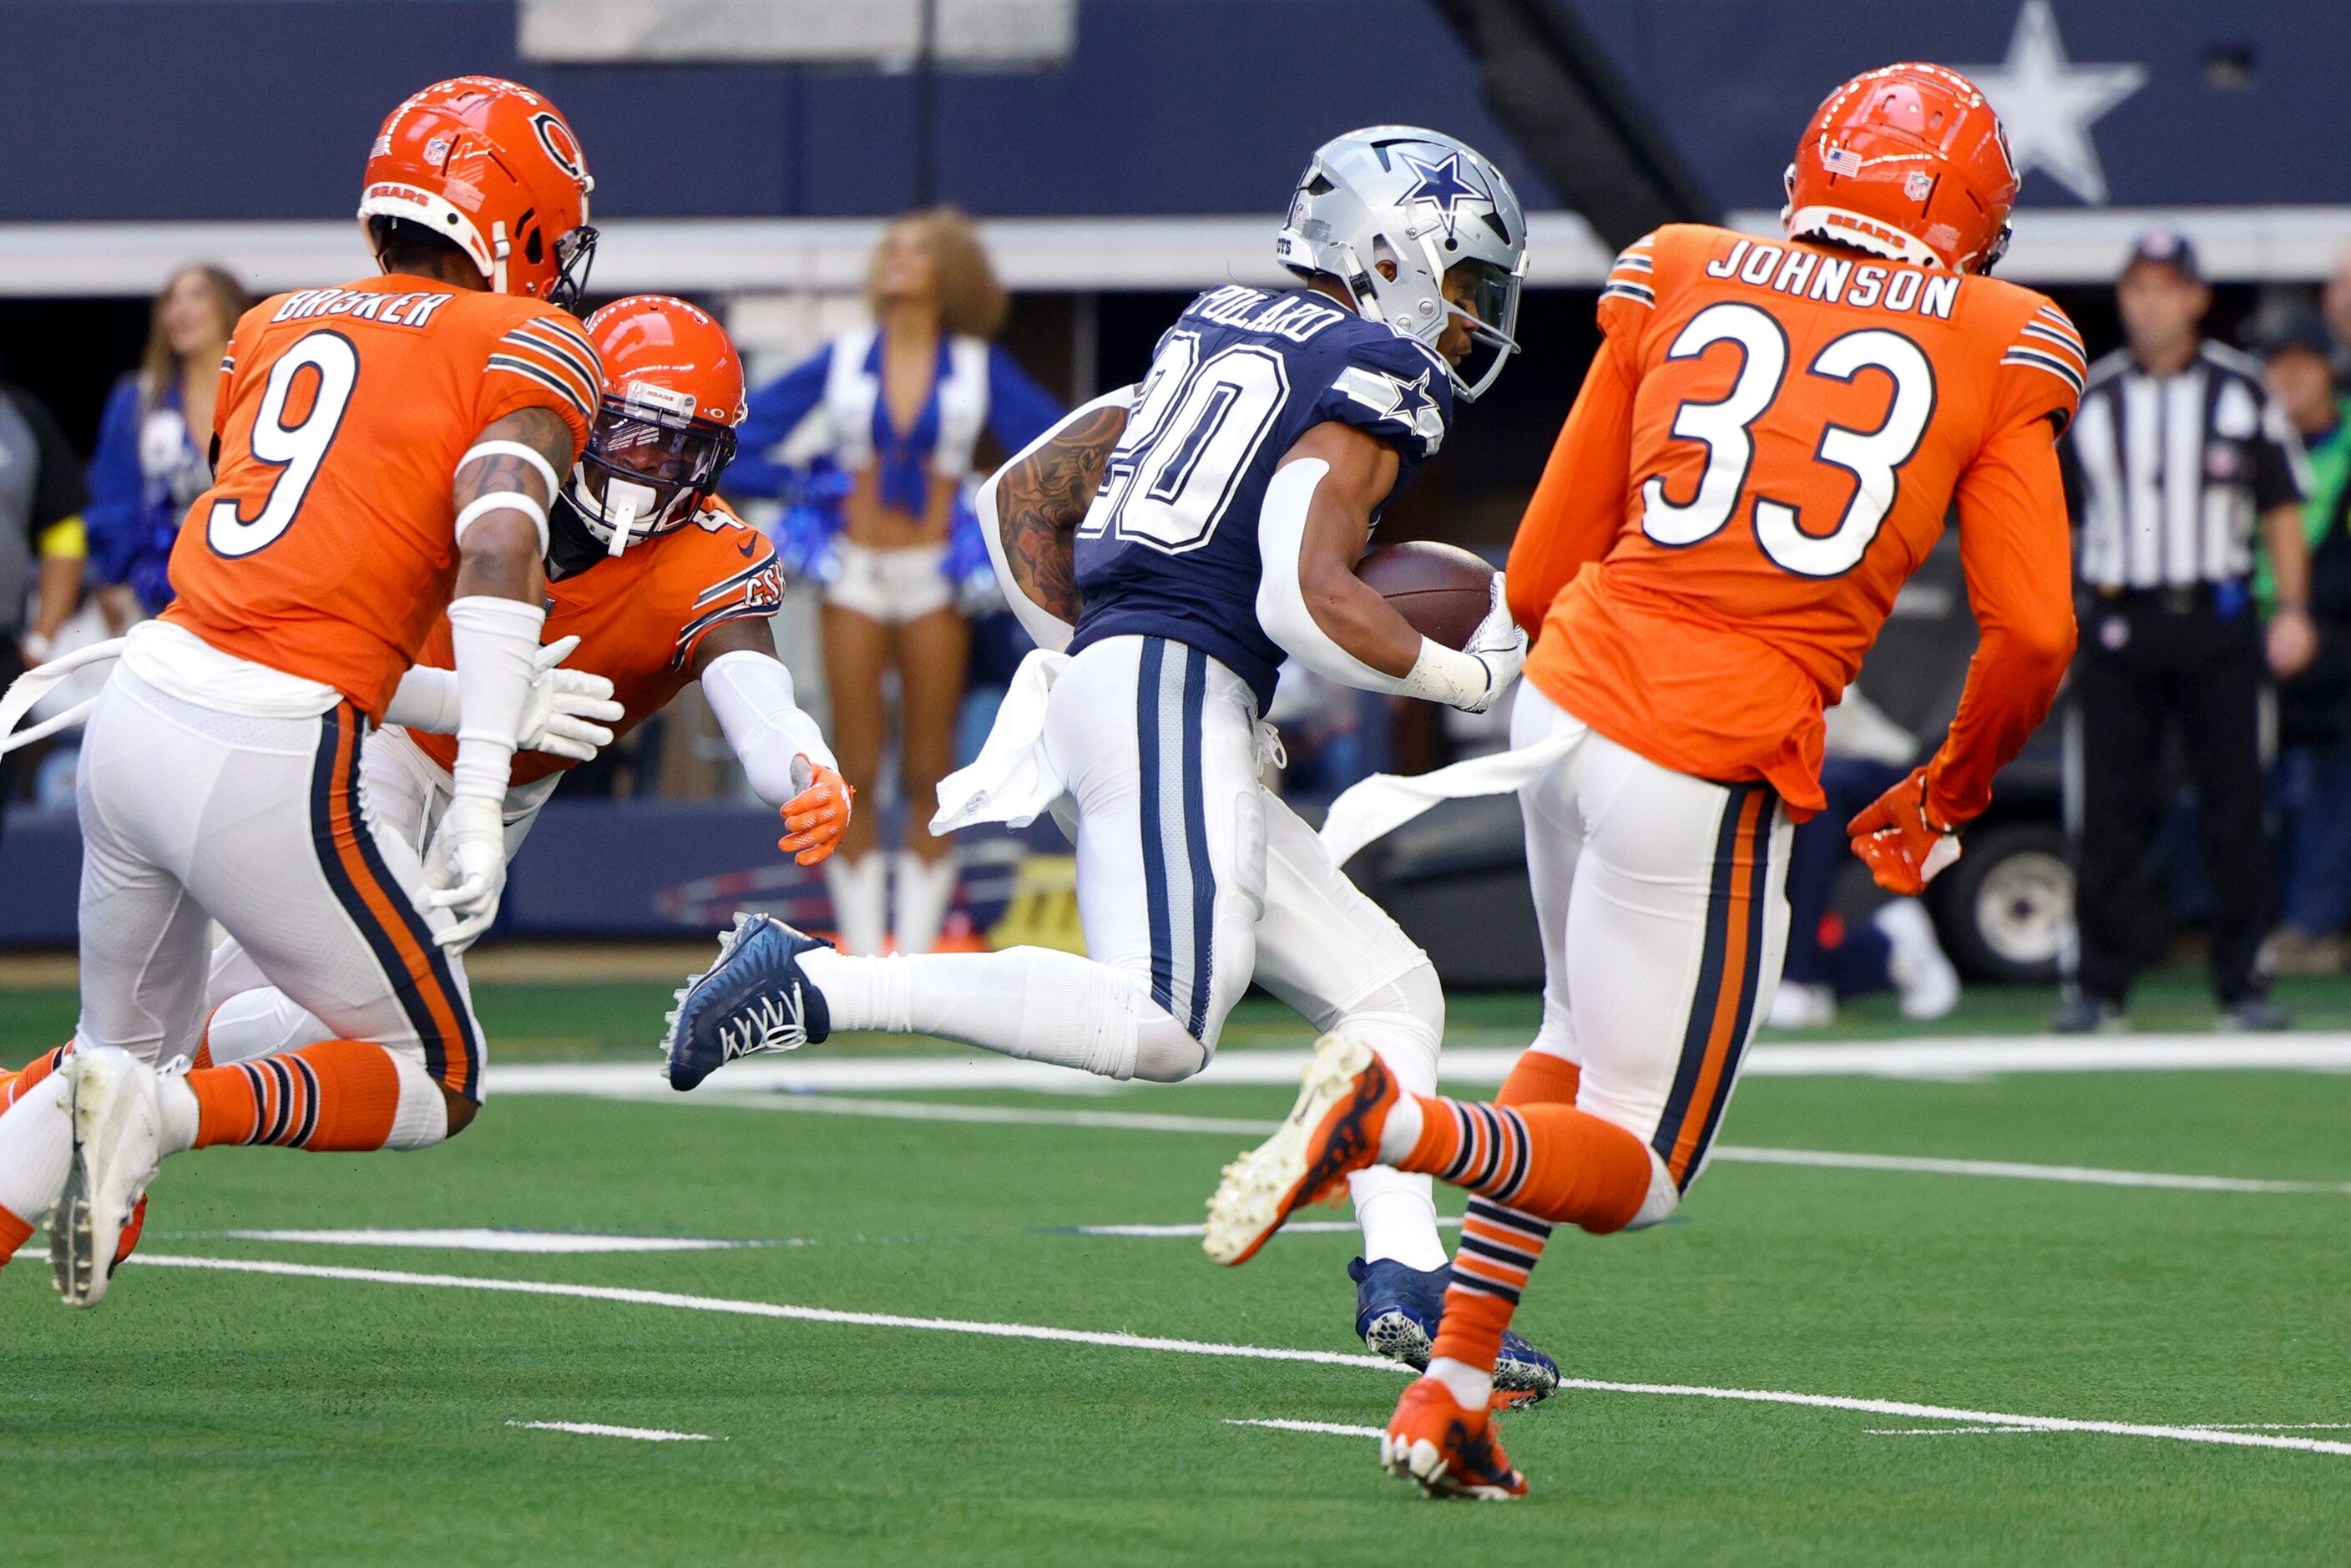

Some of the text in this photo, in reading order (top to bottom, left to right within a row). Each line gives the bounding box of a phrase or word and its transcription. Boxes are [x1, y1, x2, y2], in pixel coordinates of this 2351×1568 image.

[371, 185, 428, 207] BEARS
[1828, 214, 1906, 250] BEARS
[271, 288, 454, 327] BRISKER
[1186, 284, 1345, 343] POLLARD
[1706, 240, 1962, 319] JOHNSON
[207, 329, 359, 559] 9
[1076, 330, 1291, 555] 20
[1642, 301, 1936, 579] 33
